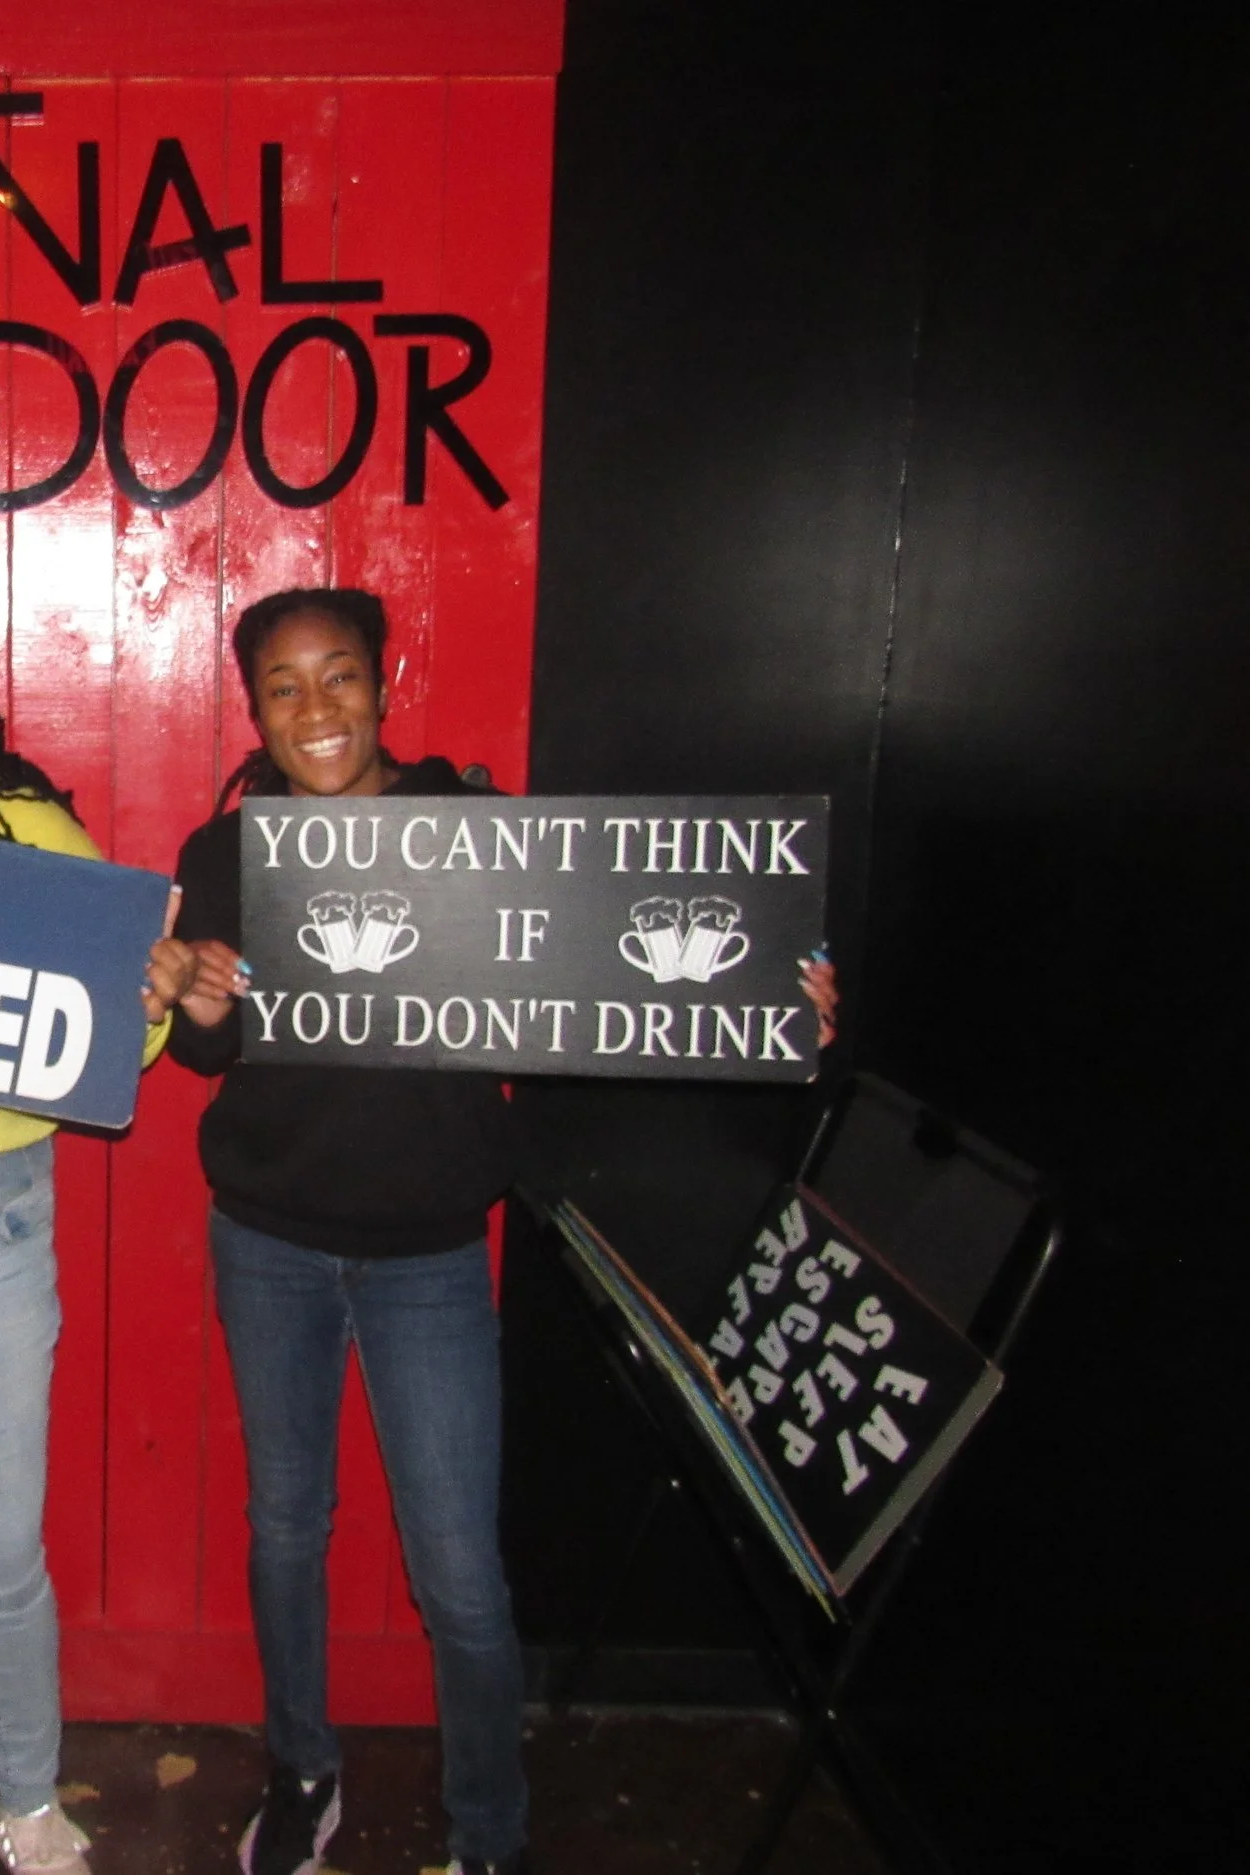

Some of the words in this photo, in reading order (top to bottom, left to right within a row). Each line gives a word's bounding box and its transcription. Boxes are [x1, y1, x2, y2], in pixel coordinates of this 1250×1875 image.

[254, 815, 380, 871] YOU
[400, 816, 587, 873] CAN'T
[604, 817, 811, 876] THINK
[493, 907, 550, 963] IF
[249, 990, 375, 1046] YOU
[393, 995, 577, 1054] DON'T
[592, 1001, 804, 1062] DRINK
[704, 1199, 810, 1368] REPEA
[777, 1296, 895, 1468] SLEEP
[836, 1364, 929, 1495] EAT
